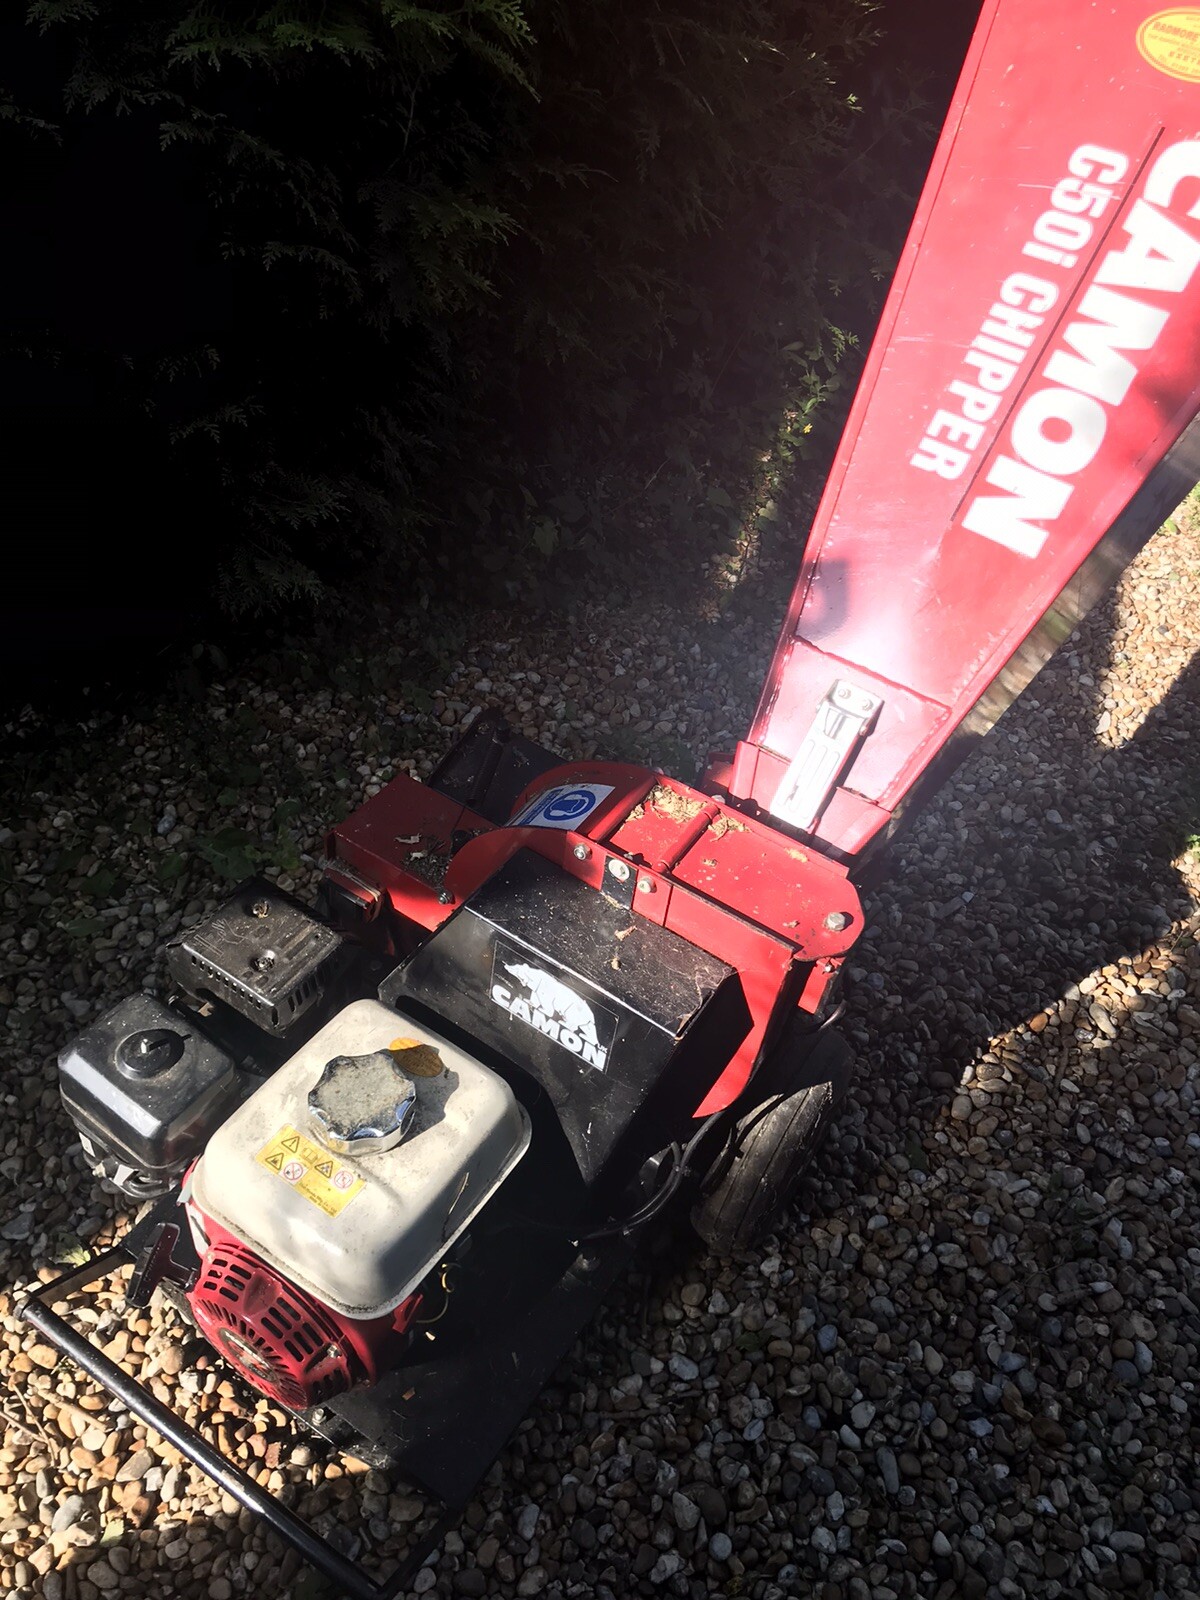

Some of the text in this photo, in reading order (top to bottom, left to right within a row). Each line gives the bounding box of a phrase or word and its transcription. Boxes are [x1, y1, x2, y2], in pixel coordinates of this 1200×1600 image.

[909, 143, 1129, 481] C50i CHIPPER
[961, 139, 1200, 560] CAMON
[492, 984, 607, 1071] CAMON
